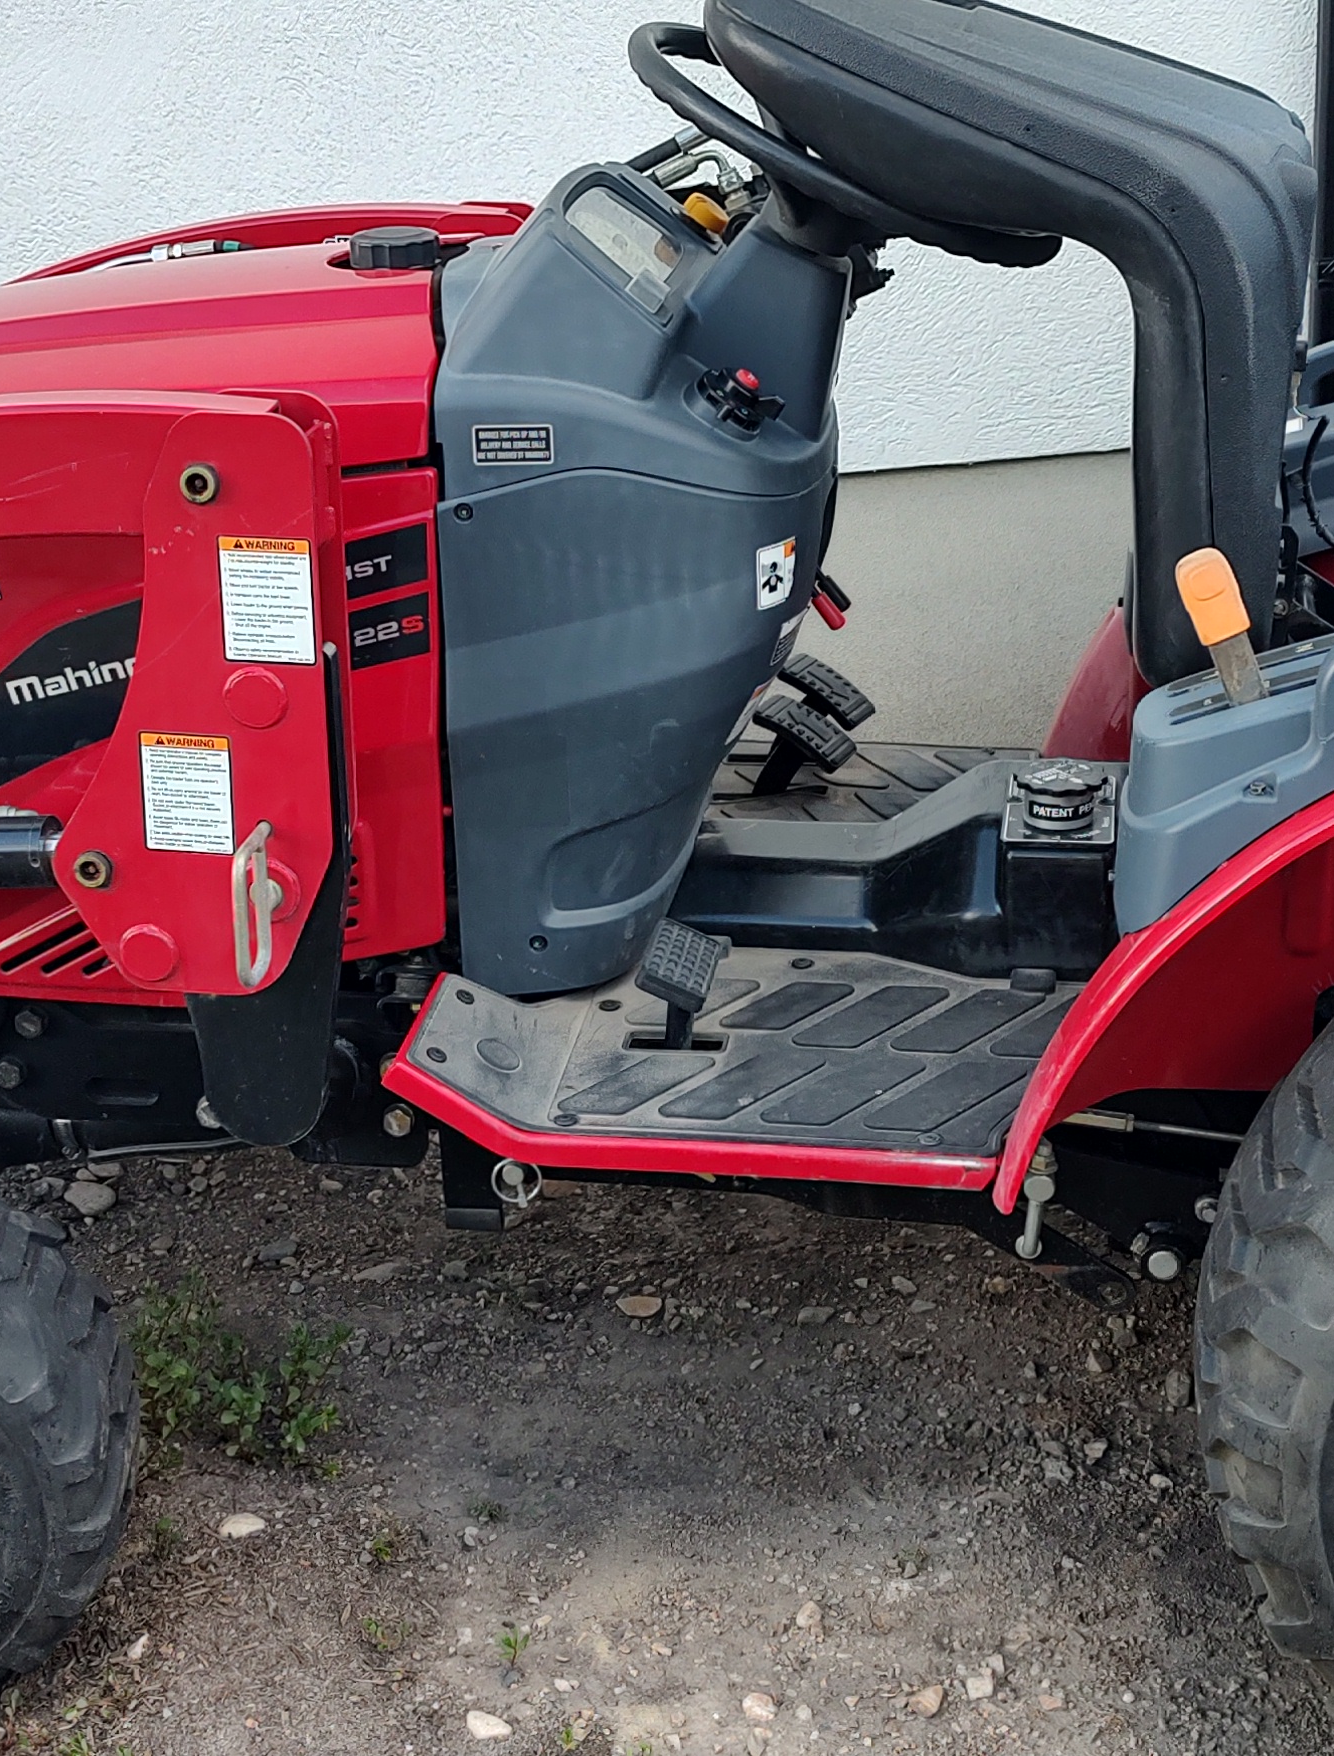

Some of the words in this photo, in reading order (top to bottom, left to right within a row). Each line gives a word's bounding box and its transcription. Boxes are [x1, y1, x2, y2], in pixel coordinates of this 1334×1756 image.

[244, 539, 295, 551] WARNING
[165, 736, 215, 748] WARNING
[1033, 805, 1074, 817] PATENT
